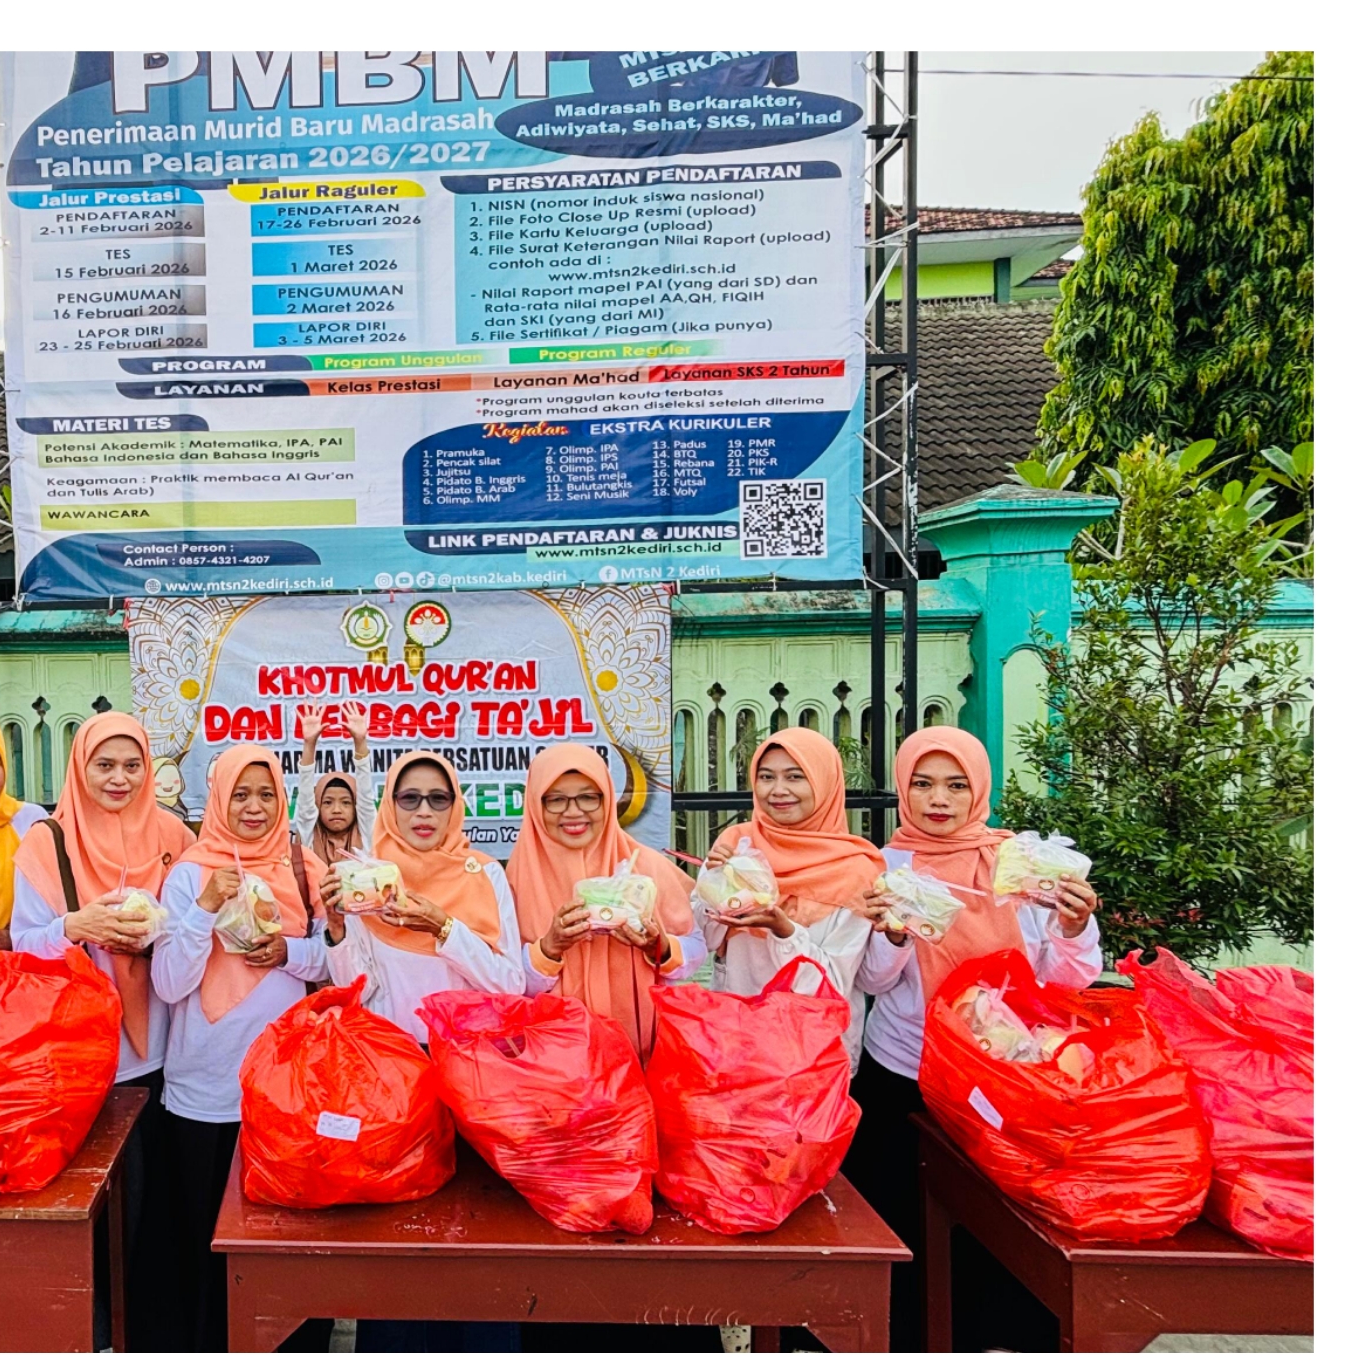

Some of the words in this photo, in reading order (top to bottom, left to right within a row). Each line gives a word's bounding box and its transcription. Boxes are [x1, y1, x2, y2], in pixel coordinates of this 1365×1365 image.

[111, 51, 550, 114] PMBM
[555, 101, 661, 117] Madrasah
[669, 95, 802, 112] Berkarakter,
[37, 121, 196, 146] Penerimaan
[204, 116, 281, 140] Murid
[291, 117, 352, 137] Baru
[362, 107, 493, 134] Madrasah
[516, 122, 627, 137] Adiwiyata,
[633, 116, 701, 131] Sehat,
[707, 114, 756, 129] SKS,
[763, 110, 842, 127] Ma'had
[36, 156, 132, 178] Tahun
[143, 150, 298, 176] Pelajaran
[309, 141, 491, 169] 2026/2027
[488, 172, 639, 191] PERSYARATAN
[647, 165, 801, 183] PENDAFTARAN
[39, 193, 88, 207] Jalur
[95, 188, 180, 202] Prestasi
[260, 187, 309, 200] Jalur
[316, 184, 397, 198] Raguler
[471, 202, 482, 212] 1.
[489, 200, 525, 211] NISN
[531, 199, 587, 211] (nomor
[594, 194, 637, 206] induk
[644, 192, 685, 202] siswa
[691, 188, 764, 201] nasional)
[56, 210, 176, 222] PENDAFTARAN
[278, 204, 399, 216] PENDAFTARAN
[40, 226, 74, 235] 2-11
[81, 223, 149, 234] Februari
[155, 221, 193, 231] 2026
[258, 220, 302, 229] 17-26
[309, 217, 377, 227] Februari
[383, 216, 421, 225] 2026
[328, 244, 353, 255] TES
[291, 263, 297, 273] 1
[305, 261, 354, 272] Maret
[359, 259, 397, 271] 2026
[549, 264, 736, 282] www.mtsn2kediri.sch.id
[152, 359, 266, 372] PROGRAM
[325, 356, 394, 370] Program
[401, 353, 482, 368] Unggulan
[539, 347, 617, 362] Program
[623, 344, 692, 358] Reguler
[154, 383, 264, 396] LAYANAN
[327, 381, 372, 393] Kelas
[378, 379, 440, 392] Prestasi
[494, 375, 568, 390] Layanan
[573, 371, 639, 385] Ma'had
[663, 366, 733, 381] Layanan
[737, 365, 764, 378] SKS
[769, 365, 778, 377] 2
[782, 364, 829, 376] Tahun
[53, 418, 129, 432] MATERI
[134, 417, 171, 430] TES
[482, 420, 569, 444] Kegiatan
[590, 420, 663, 435] EKSTRA
[669, 416, 771, 430] KURIKULER
[48, 509, 150, 519] WAWANCARA
[428, 535, 477, 549] LINK
[482, 529, 636, 547] PENDAFTARAN
[641, 527, 658, 541] &
[663, 525, 737, 539] JUKNIS
[123, 544, 177, 554] Contact
[182, 543, 226, 554] Person
[536, 542, 721, 558] www.mtsn2kediri.sch.id
[124, 556, 168, 566] Admin
[180, 555, 270, 565] 0857-4321-4207
[437, 570, 567, 586] @mtsn2kab.kediri
[621, 566, 662, 579] MTsN
[667, 566, 676, 577] 2
[678, 565, 721, 577] Kediri
[165, 577, 333, 592] www.mtsn2kediri.sch.id
[258, 662, 414, 696] KHOTMUL
[423, 660, 536, 696] QUR'AN
[204, 704, 283, 741] DAN
